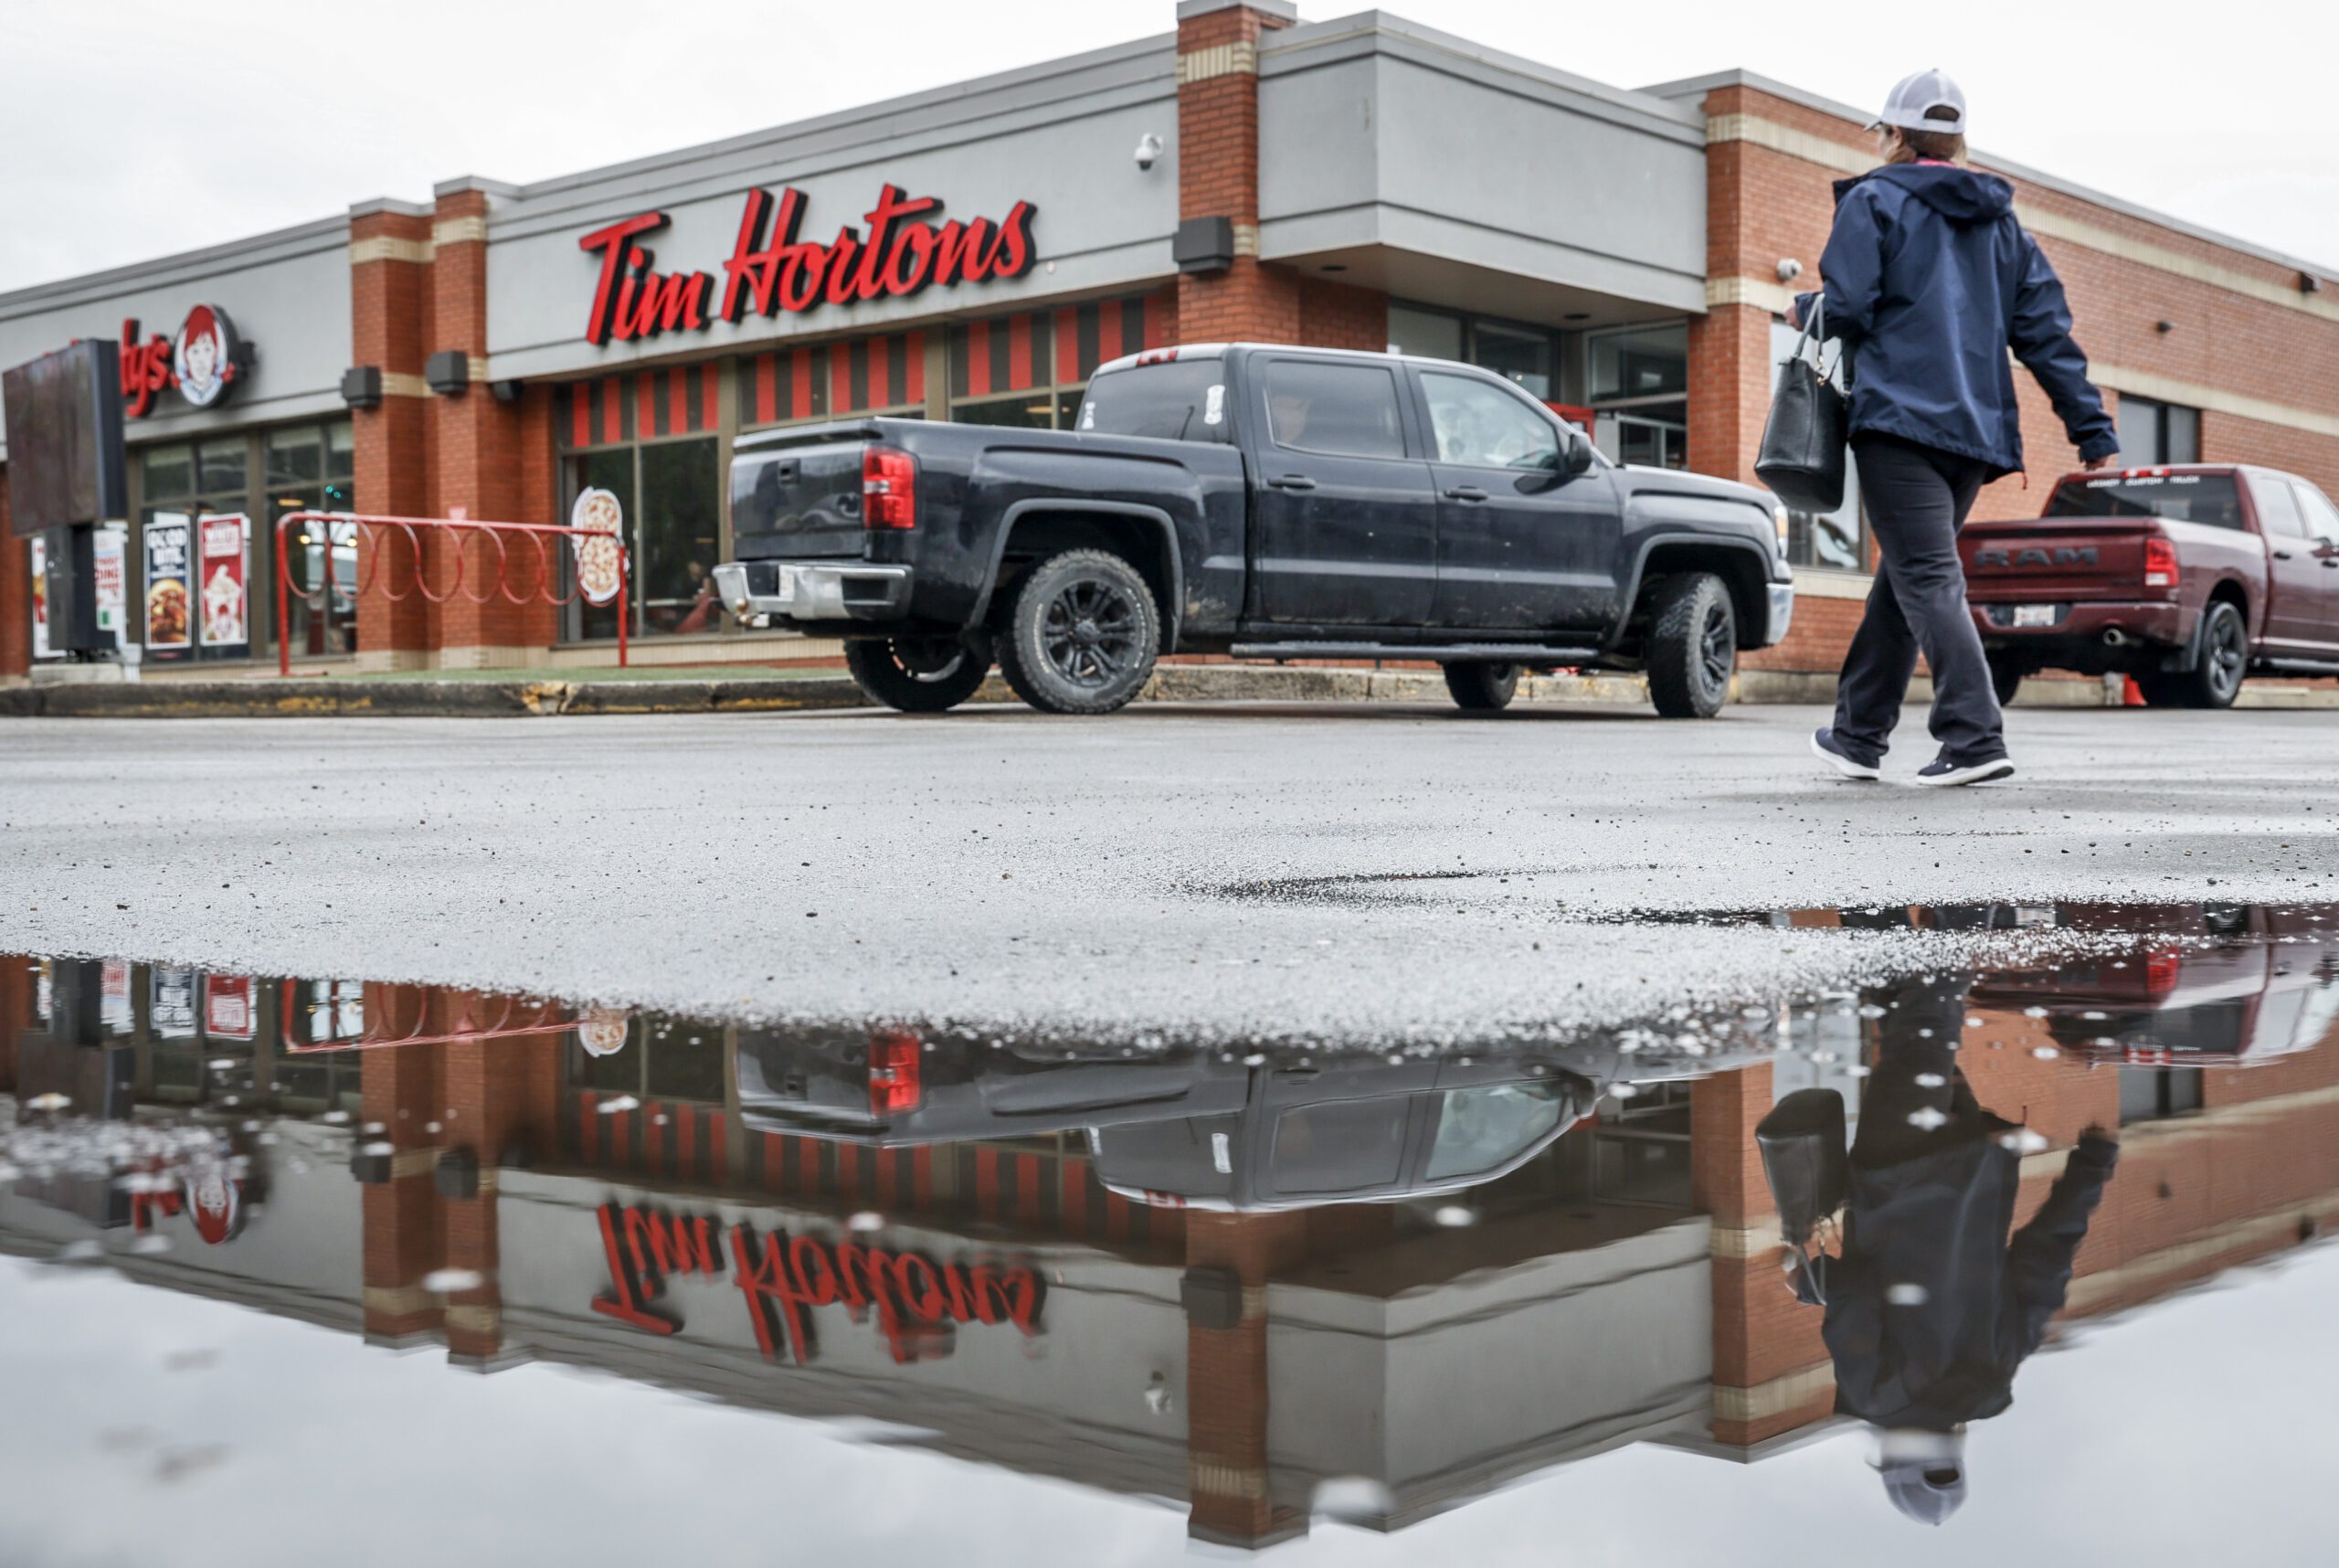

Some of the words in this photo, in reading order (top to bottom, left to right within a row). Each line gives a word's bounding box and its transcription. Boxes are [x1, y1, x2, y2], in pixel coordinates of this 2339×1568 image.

[579, 211, 712, 346] Tim
[722, 184, 1034, 322] Hortons
[1974, 548, 2099, 567] RAM
